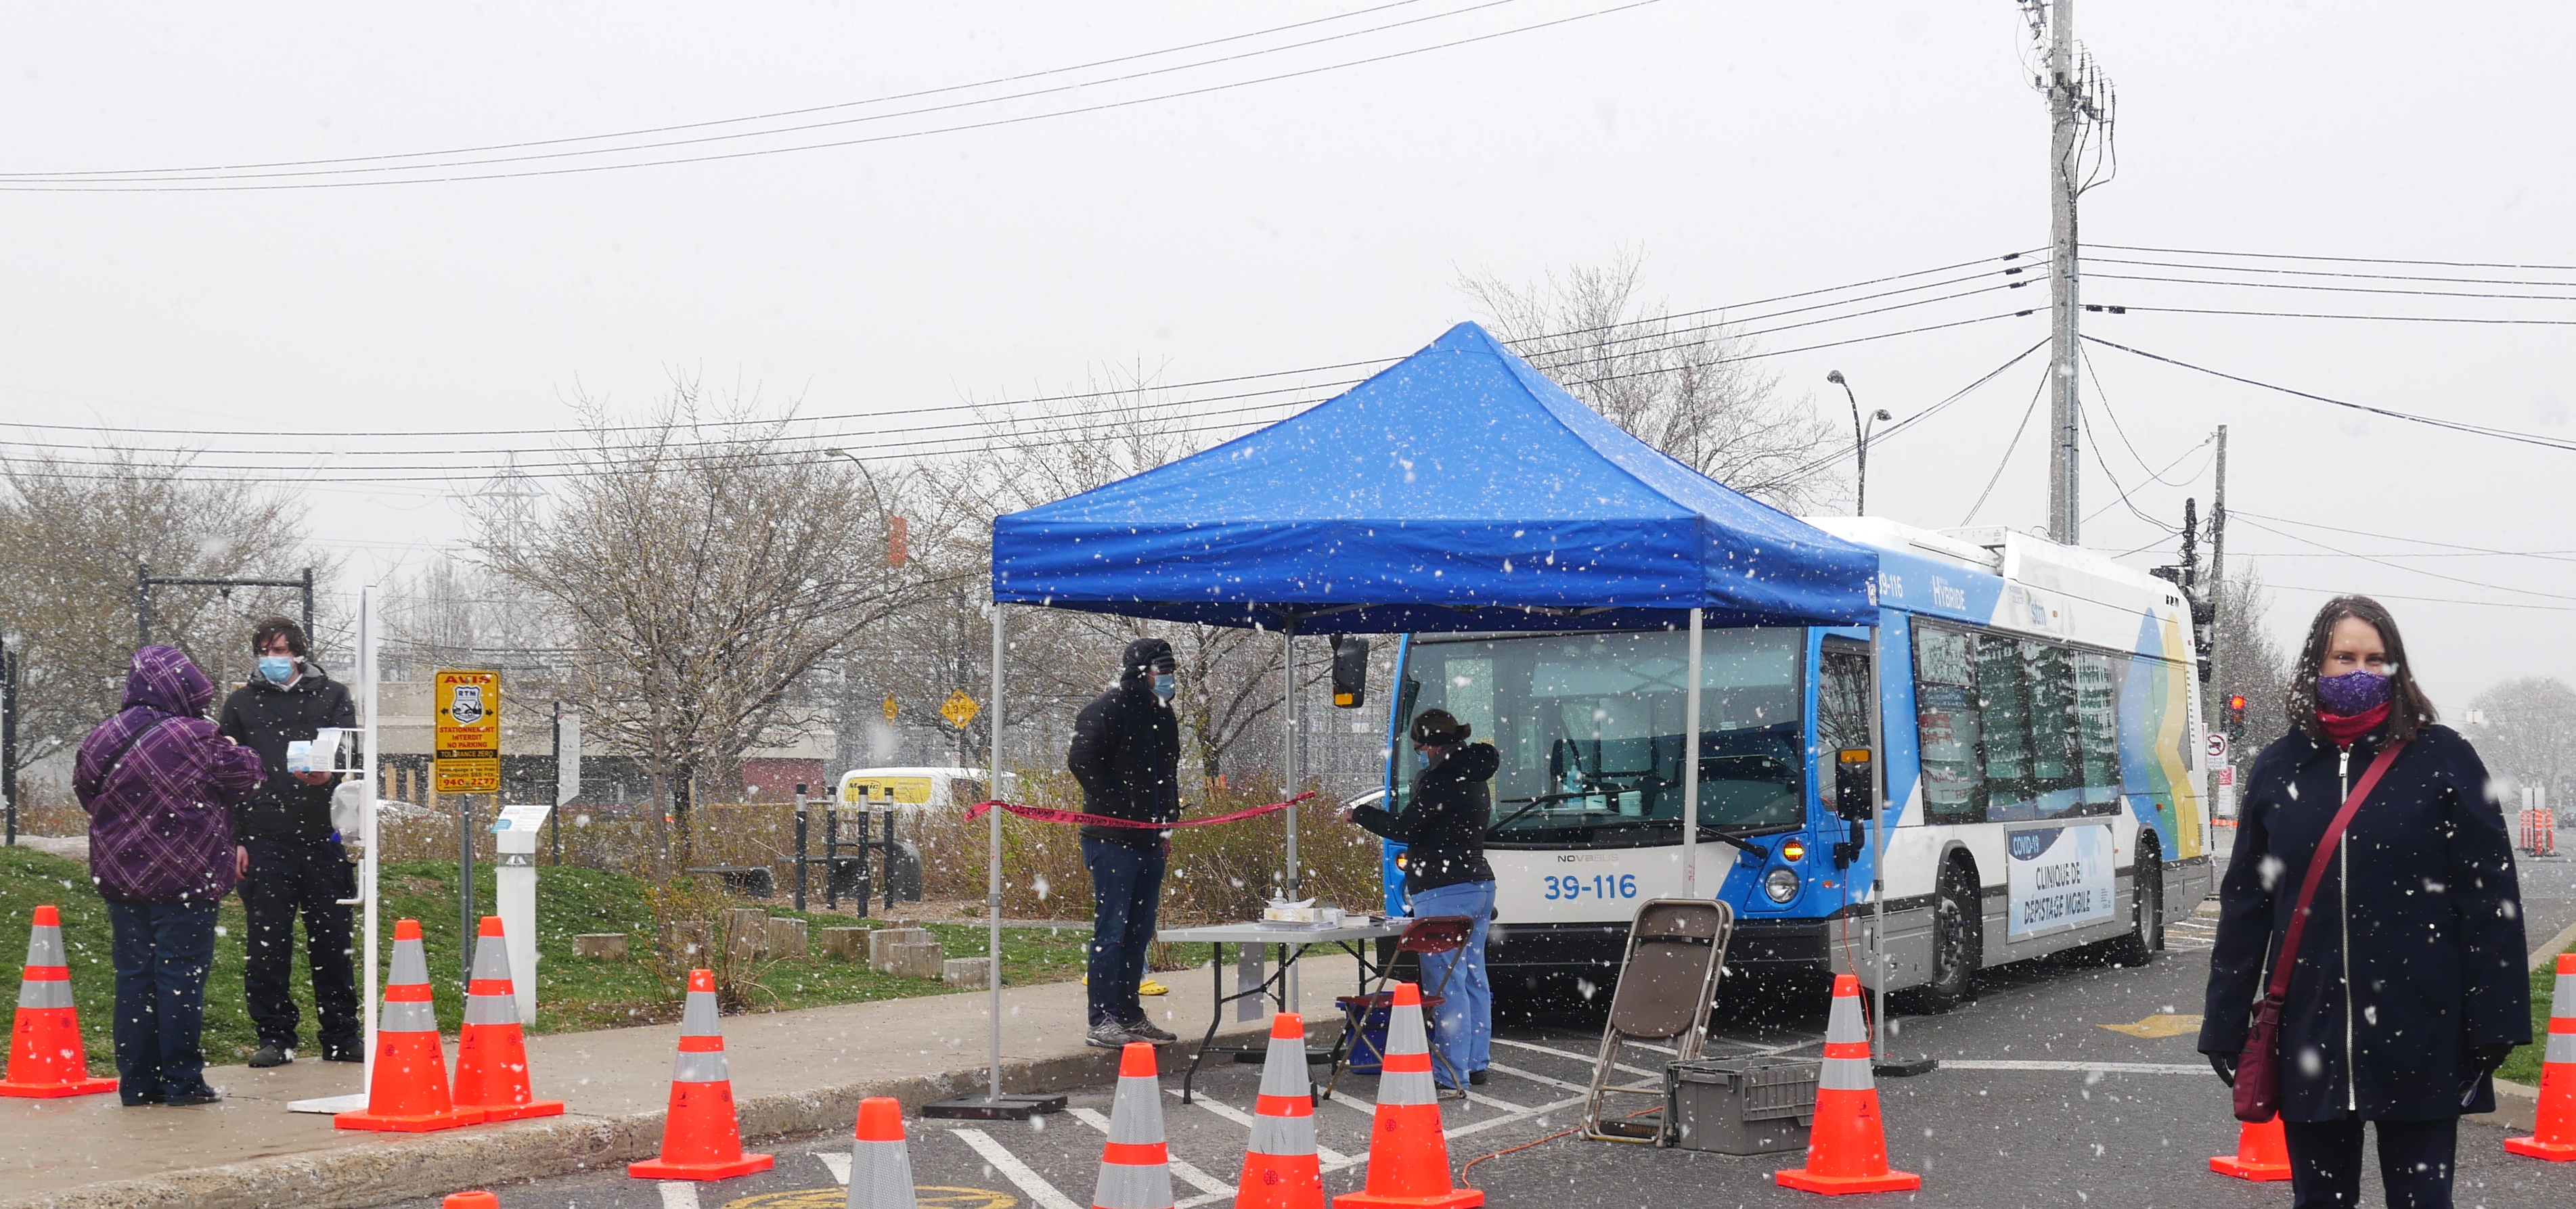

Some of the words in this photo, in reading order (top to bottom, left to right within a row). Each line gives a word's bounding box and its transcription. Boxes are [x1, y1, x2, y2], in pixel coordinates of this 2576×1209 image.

[444, 675, 491, 683] AVIS
[2013, 835, 2039, 856] COVID-19
[1544, 874, 1637, 900] 39-116
[2036, 863, 2070, 891] CLINIQUE
[2071, 861, 2081, 884] DE
[2024, 894, 2064, 925] DÉPISTAGE
[2065, 890, 2091, 916] MOBILE
